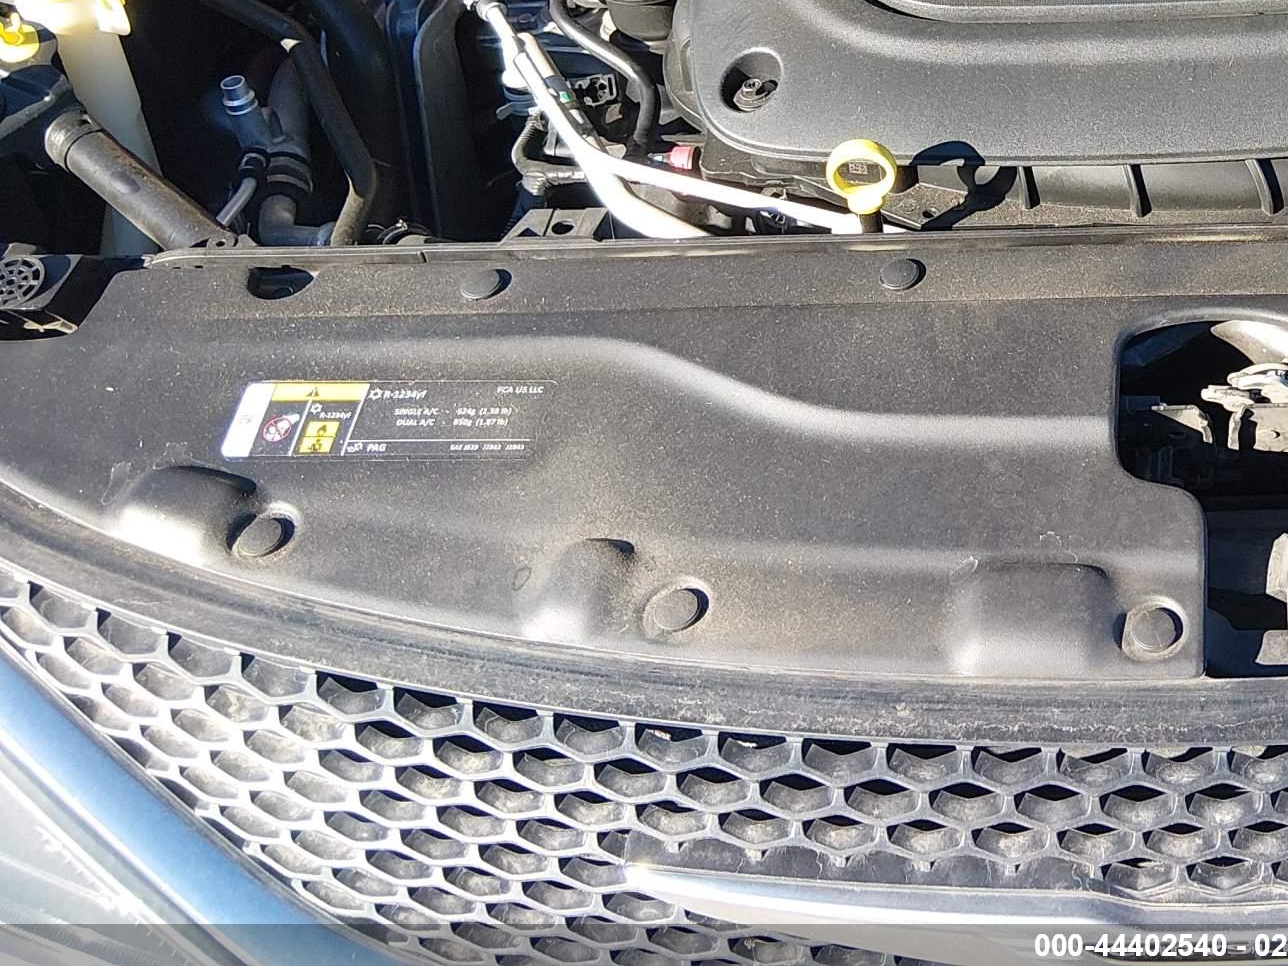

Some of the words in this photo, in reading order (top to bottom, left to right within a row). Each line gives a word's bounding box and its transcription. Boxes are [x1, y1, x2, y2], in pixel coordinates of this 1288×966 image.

[383, 388, 428, 400] R-1234yf
[496, 385, 513, 394] FCA
[515, 385, 528, 394] US
[528, 385, 545, 394] LLC
[396, 418, 418, 426] DUAL
[366, 443, 387, 452] PAG
